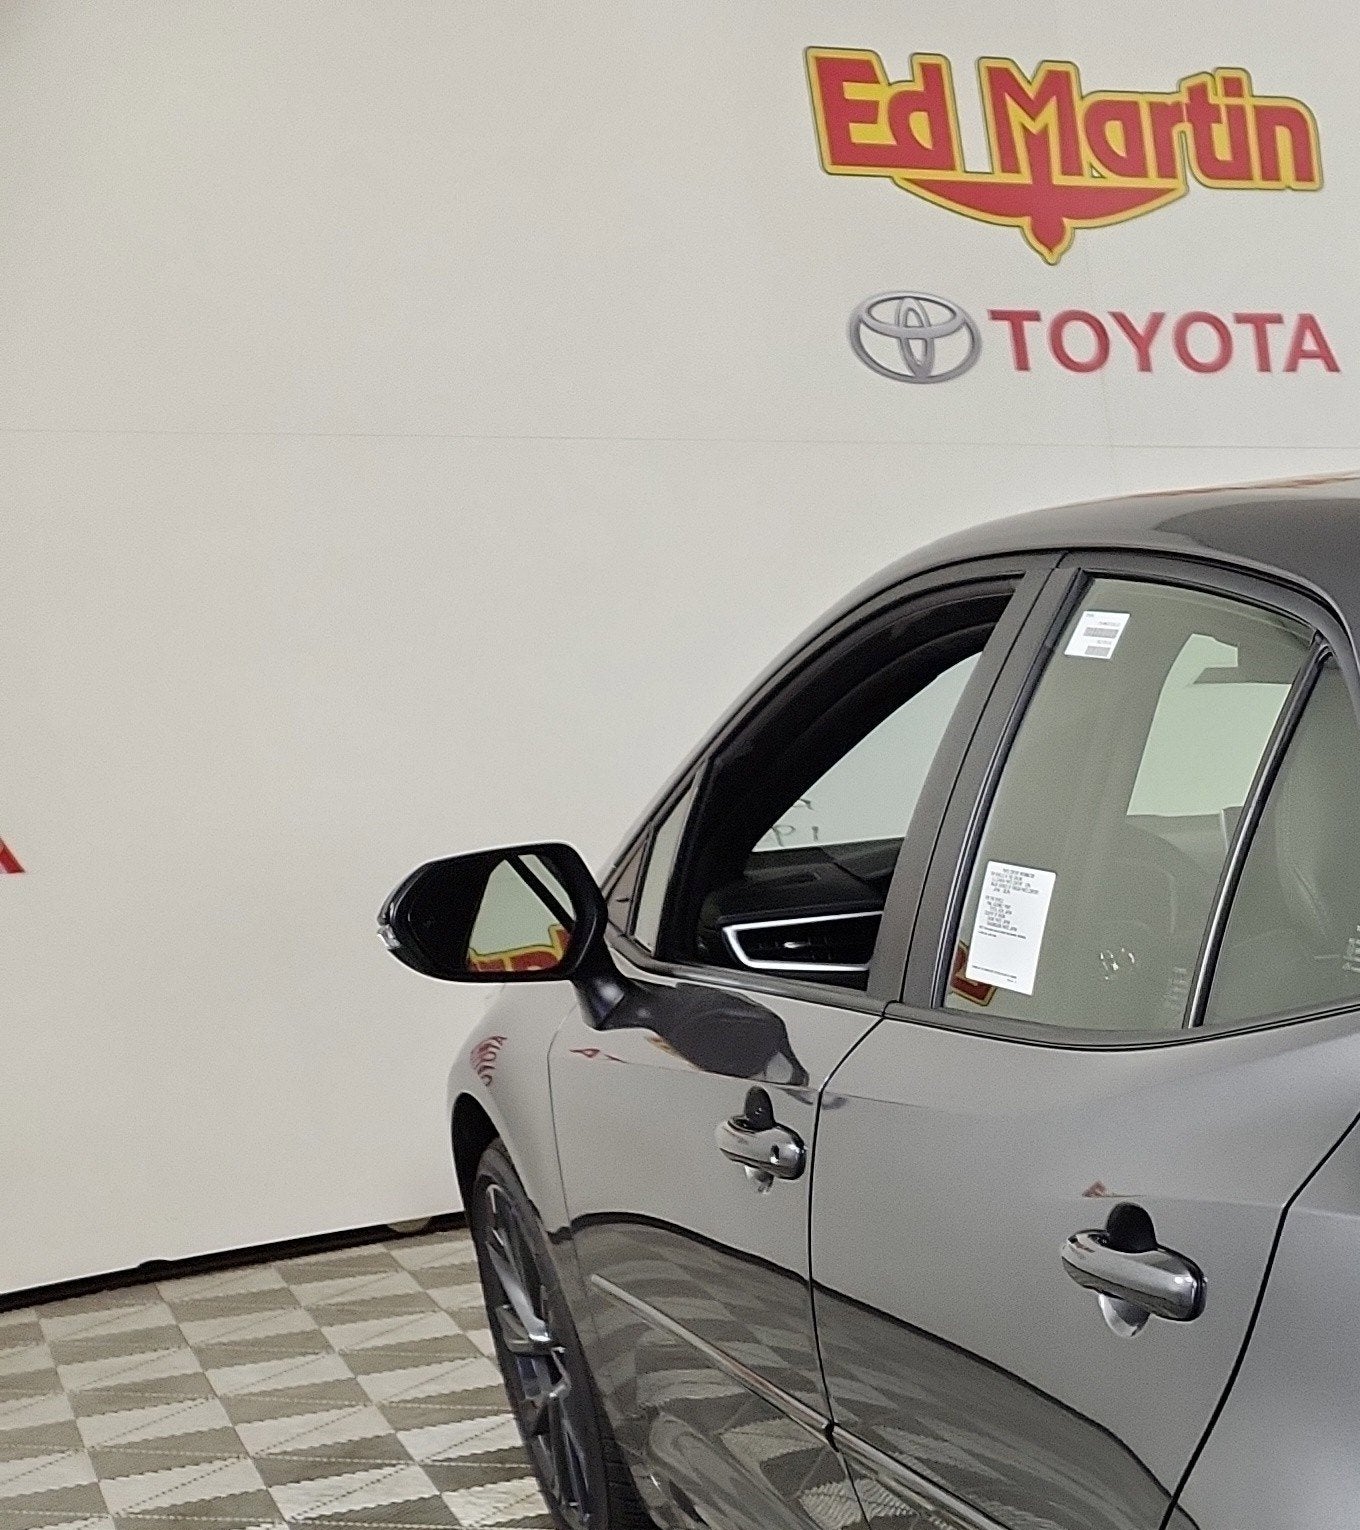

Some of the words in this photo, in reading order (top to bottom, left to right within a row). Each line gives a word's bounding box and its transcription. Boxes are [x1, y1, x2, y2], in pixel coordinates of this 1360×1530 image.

[812, 54, 958, 172] Ed
[984, 60, 1317, 183] Martin
[990, 309, 1340, 374] TOYOTA
